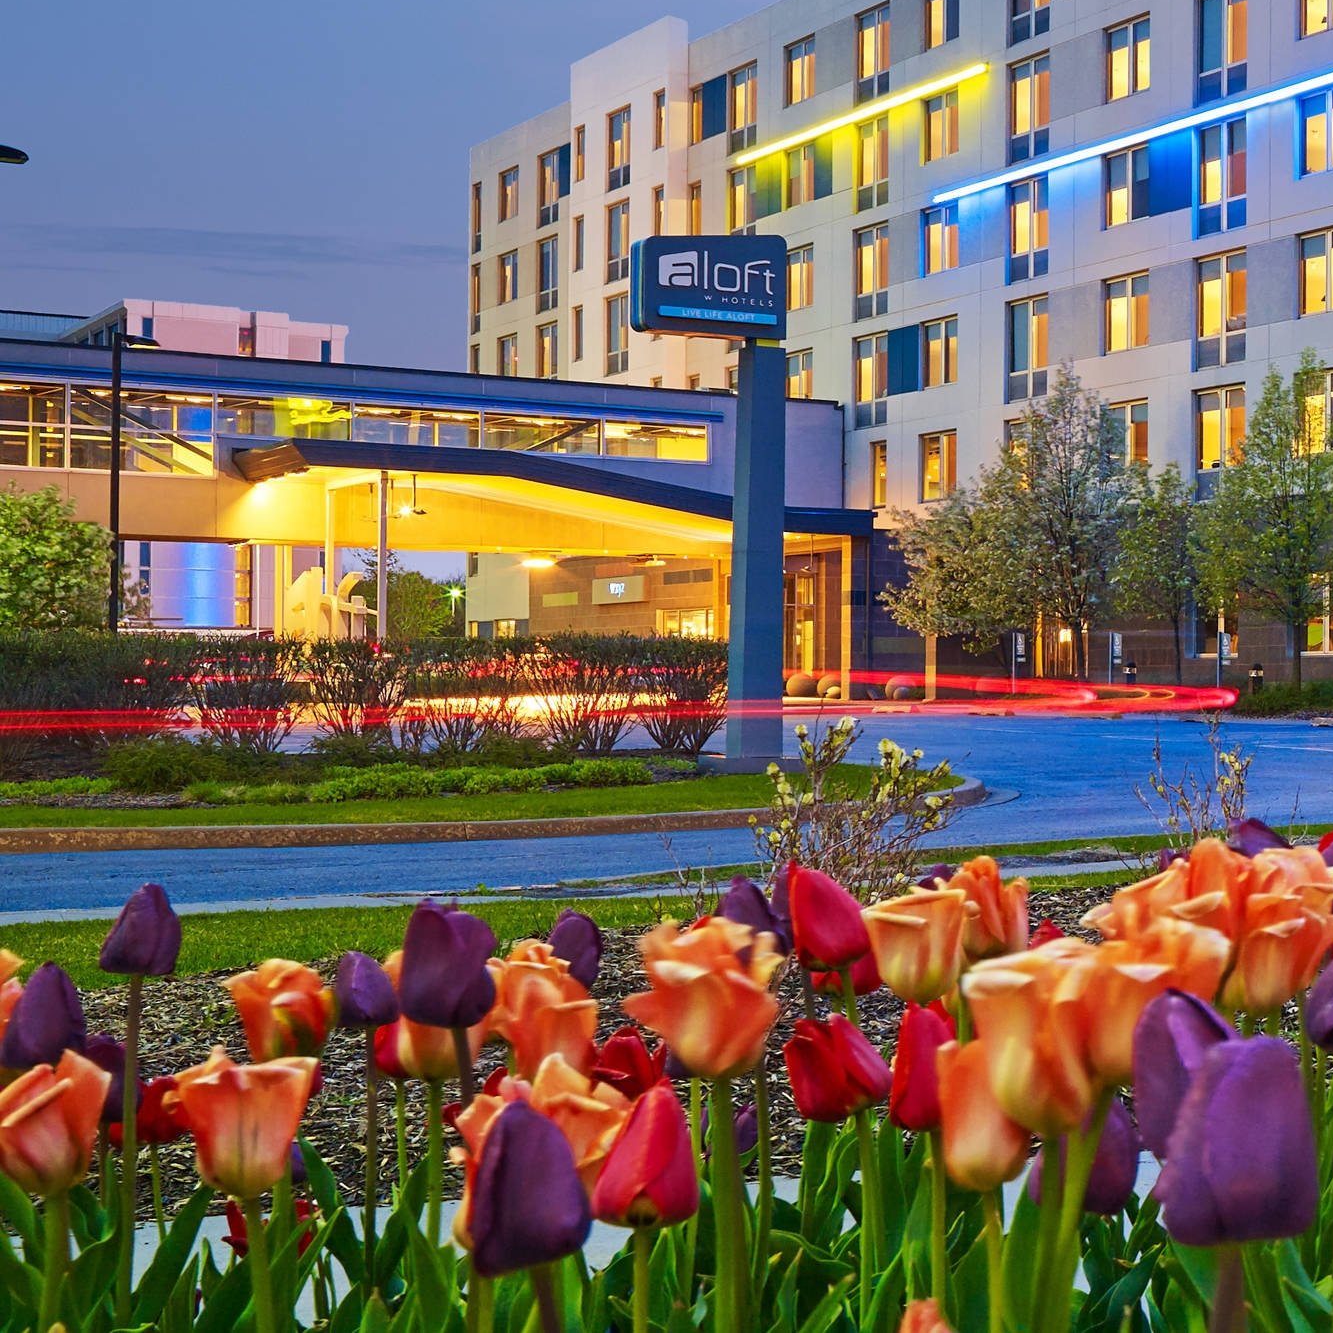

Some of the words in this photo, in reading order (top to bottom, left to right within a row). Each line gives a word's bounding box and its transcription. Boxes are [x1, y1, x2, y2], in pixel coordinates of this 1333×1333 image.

[658, 250, 776, 296] aloft
[721, 296, 774, 308] HOTELS
[681, 308, 702, 318] LIVE
[704, 310, 723, 320] LIFE
[726, 311, 756, 322] ALOFT
